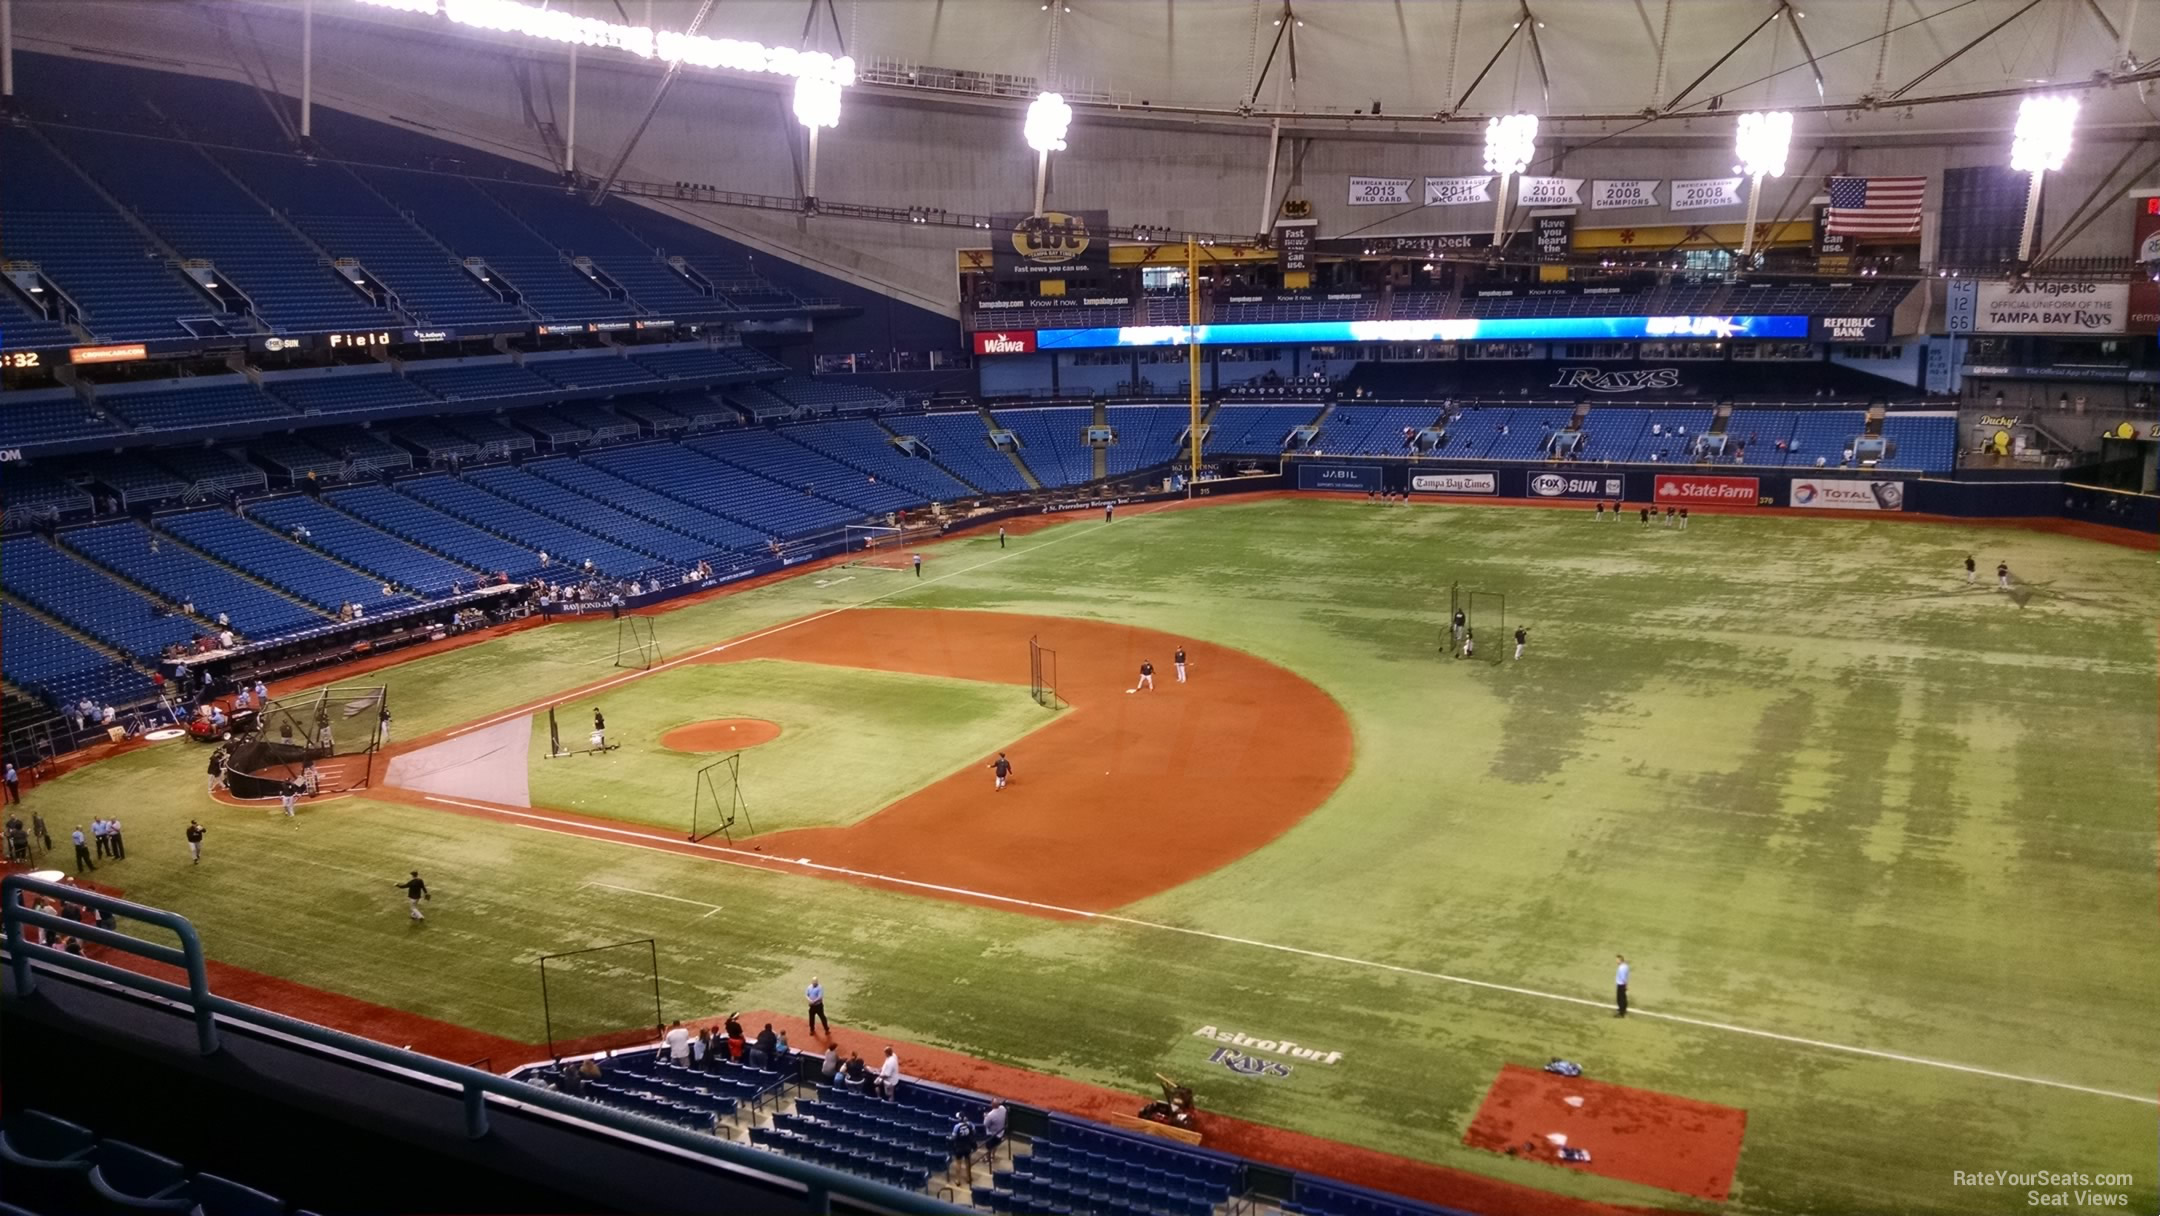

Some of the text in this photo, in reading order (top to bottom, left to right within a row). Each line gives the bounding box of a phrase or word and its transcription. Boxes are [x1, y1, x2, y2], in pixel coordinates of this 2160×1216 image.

[1365, 186, 1396, 196] 2013
[1442, 186, 1472, 196] 2011
[1532, 186, 1566, 196] 2010
[1607, 188, 1641, 199] 2008
[1687, 188, 1723, 199] 2008
[1676, 197, 1732, 207] CHAMPIONS
[1540, 220, 1565, 228] Have
[1286, 230, 1304, 238] Fast
[1543, 229, 1562, 238] you
[1438, 236, 1471, 248] Deck
[1538, 236, 1567, 244] heard
[1822, 244, 1844, 252] use.
[1953, 280, 1971, 291] 42
[2034, 282, 2096, 297] Majestic
[1084, 297, 1128, 305] tampabay.com
[1954, 297, 1968, 310] 12
[1824, 318, 1876, 327] REPUBLIC
[1951, 316, 1968, 329] 66
[1990, 313, 2038, 324] TAMPA
[2043, 313, 2072, 323] BAY
[1833, 328, 1864, 336] BANK
[284, 339, 299, 348] SUN
[330, 332, 390, 347] Field
[984, 340, 1024, 353] Wawa
[0, 353, 40, 367] :32
[1323, 470, 1357, 479] JABIL
[1416, 478, 1491, 489] Tampa Bay Times
[1540, 479, 1559, 488] FOX
[1568, 480, 1597, 493] SUN
[1192, 1025, 1344, 1064] AstroTurf
